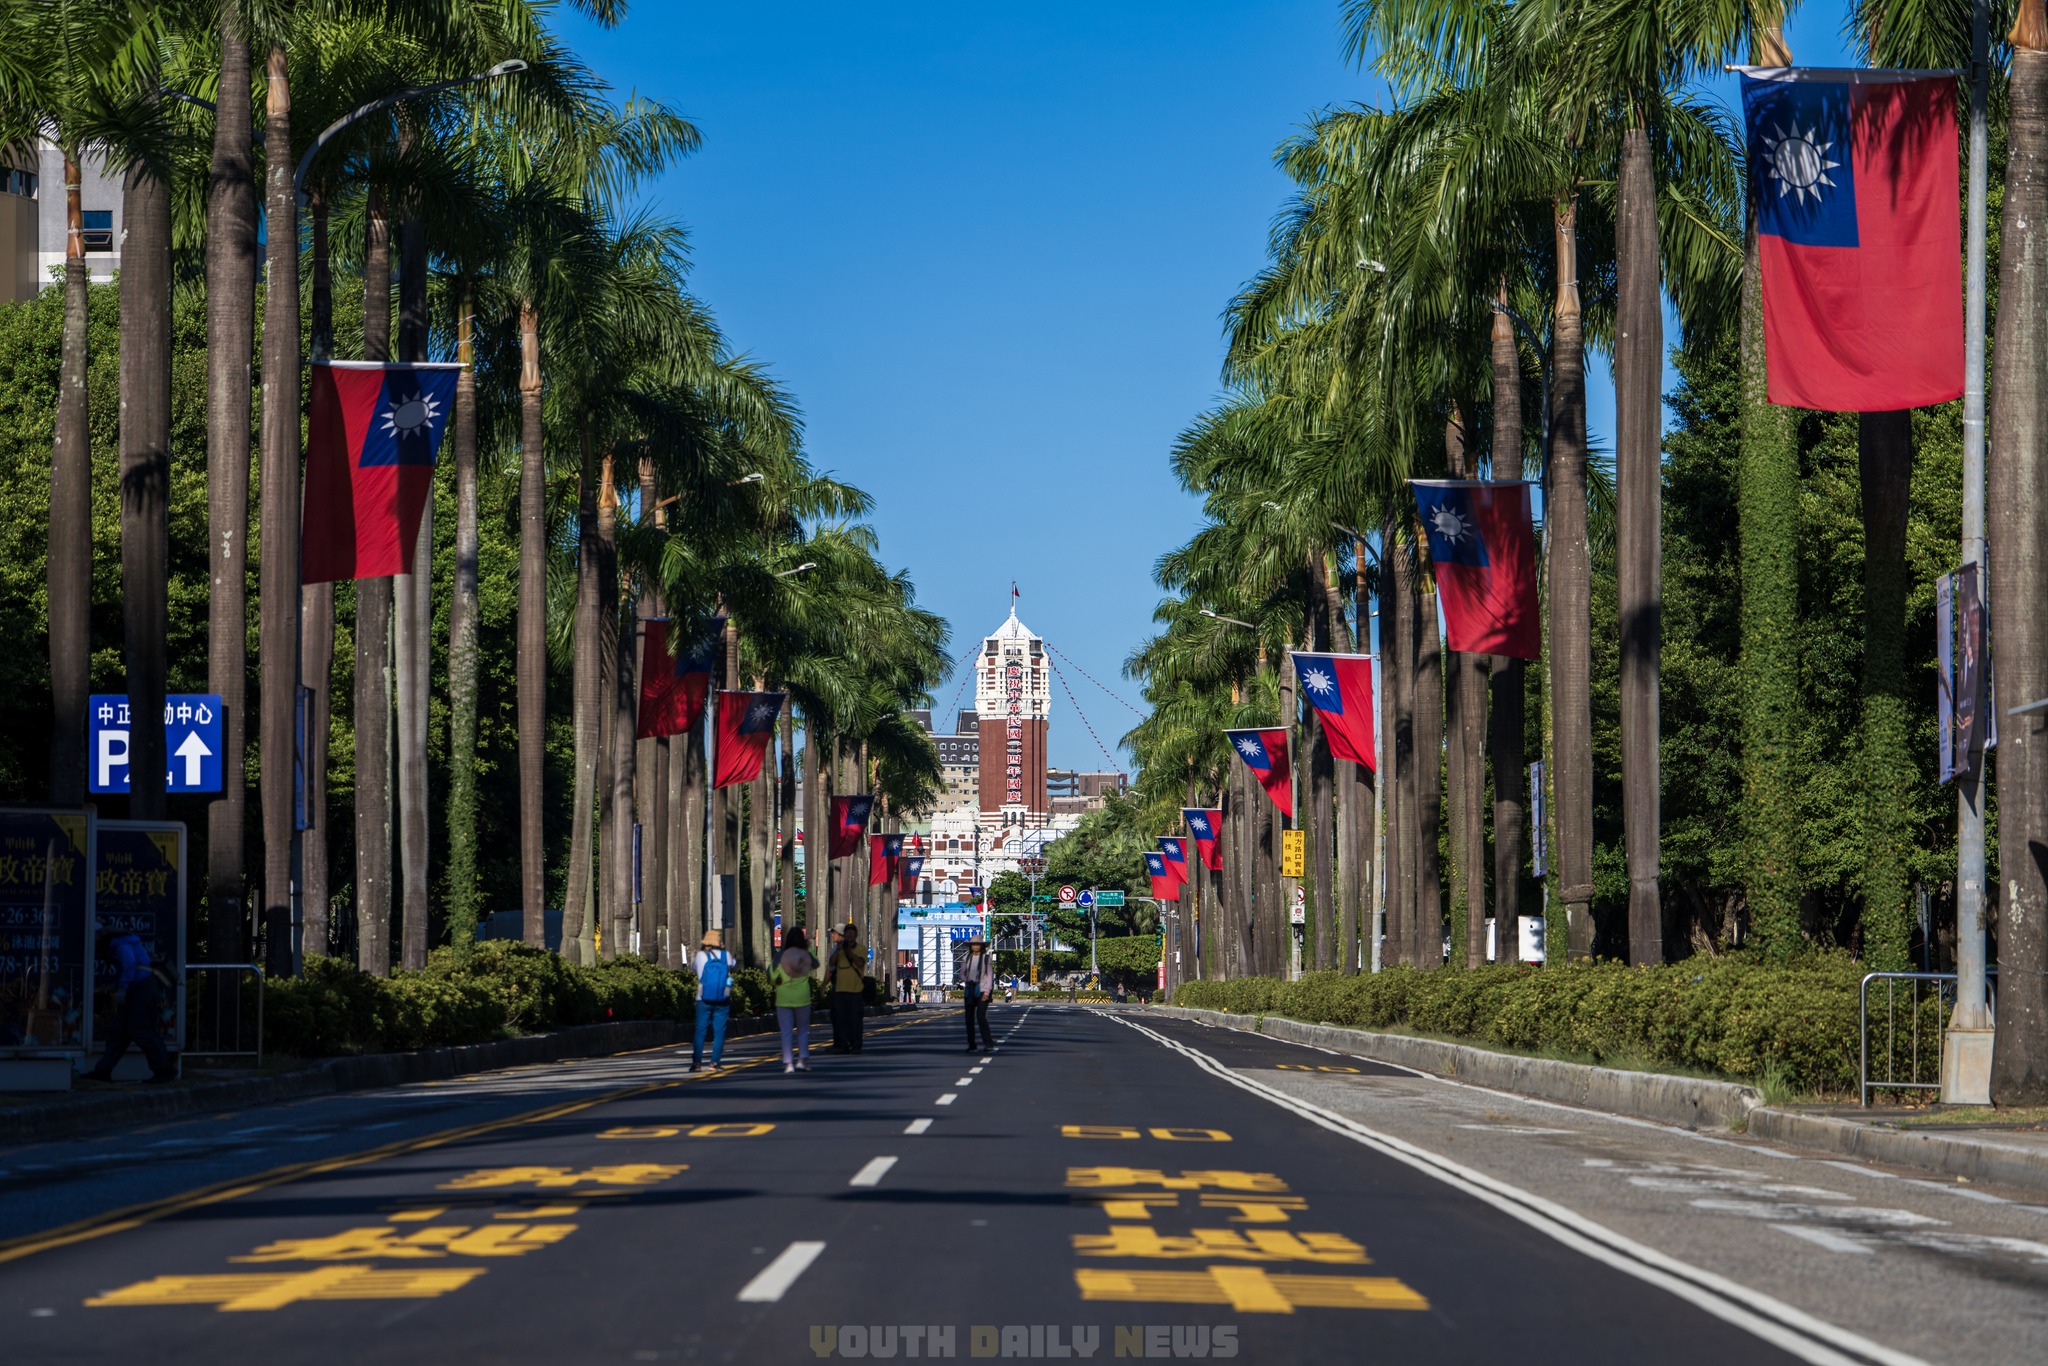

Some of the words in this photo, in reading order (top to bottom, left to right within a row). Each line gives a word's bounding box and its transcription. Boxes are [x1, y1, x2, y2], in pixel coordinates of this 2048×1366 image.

[98, 702, 213, 725] 中正中心
[1060, 1125, 1233, 1142] 50
